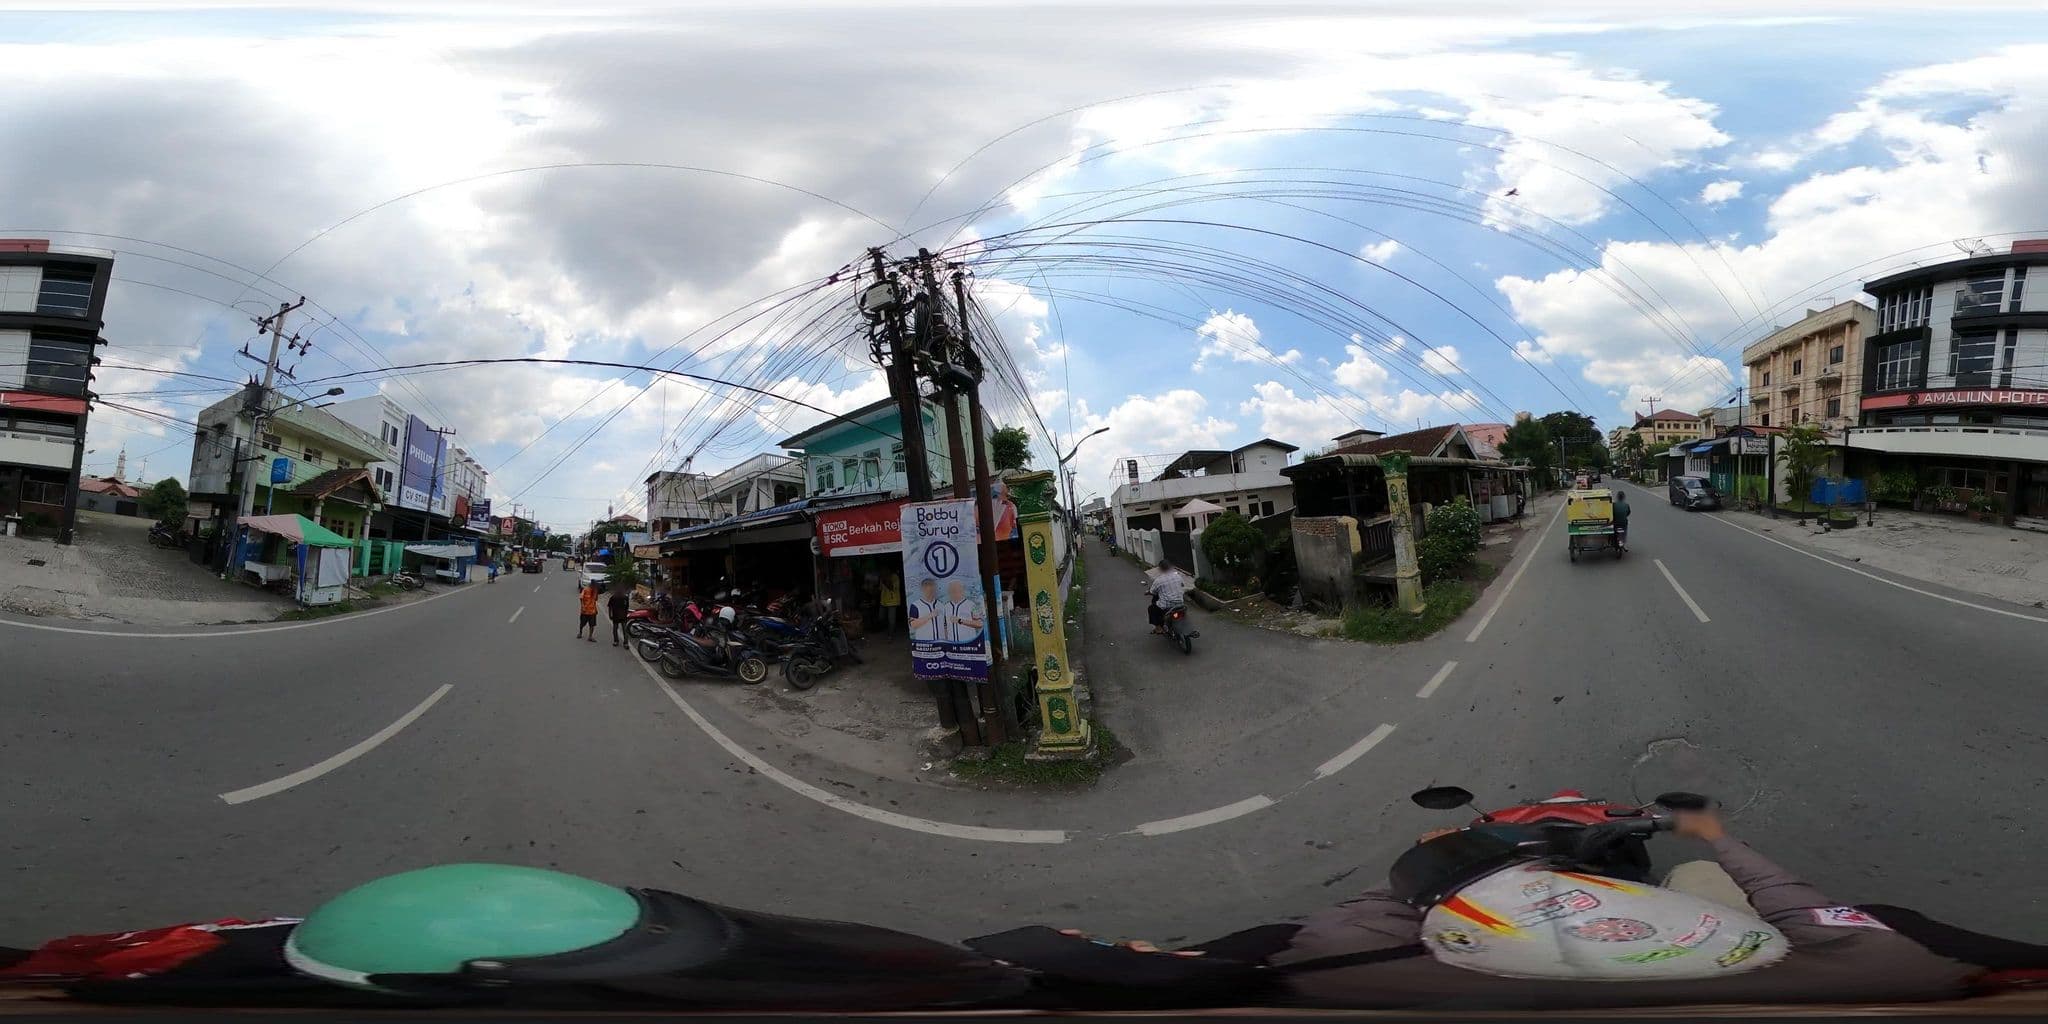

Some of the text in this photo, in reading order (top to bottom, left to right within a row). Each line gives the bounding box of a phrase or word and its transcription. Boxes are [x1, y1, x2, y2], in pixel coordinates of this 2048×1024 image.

[1923, 391, 1993, 403] AMALIUN
[405, 490, 414, 500] CV
[916, 507, 958, 522] Bobby
[823, 520, 847, 532] TOKO
[849, 518, 901, 535] Berkah Rej
[918, 522, 959, 538] Surya
[830, 533, 848, 543] SRC
[932, 546, 947, 573] 1
